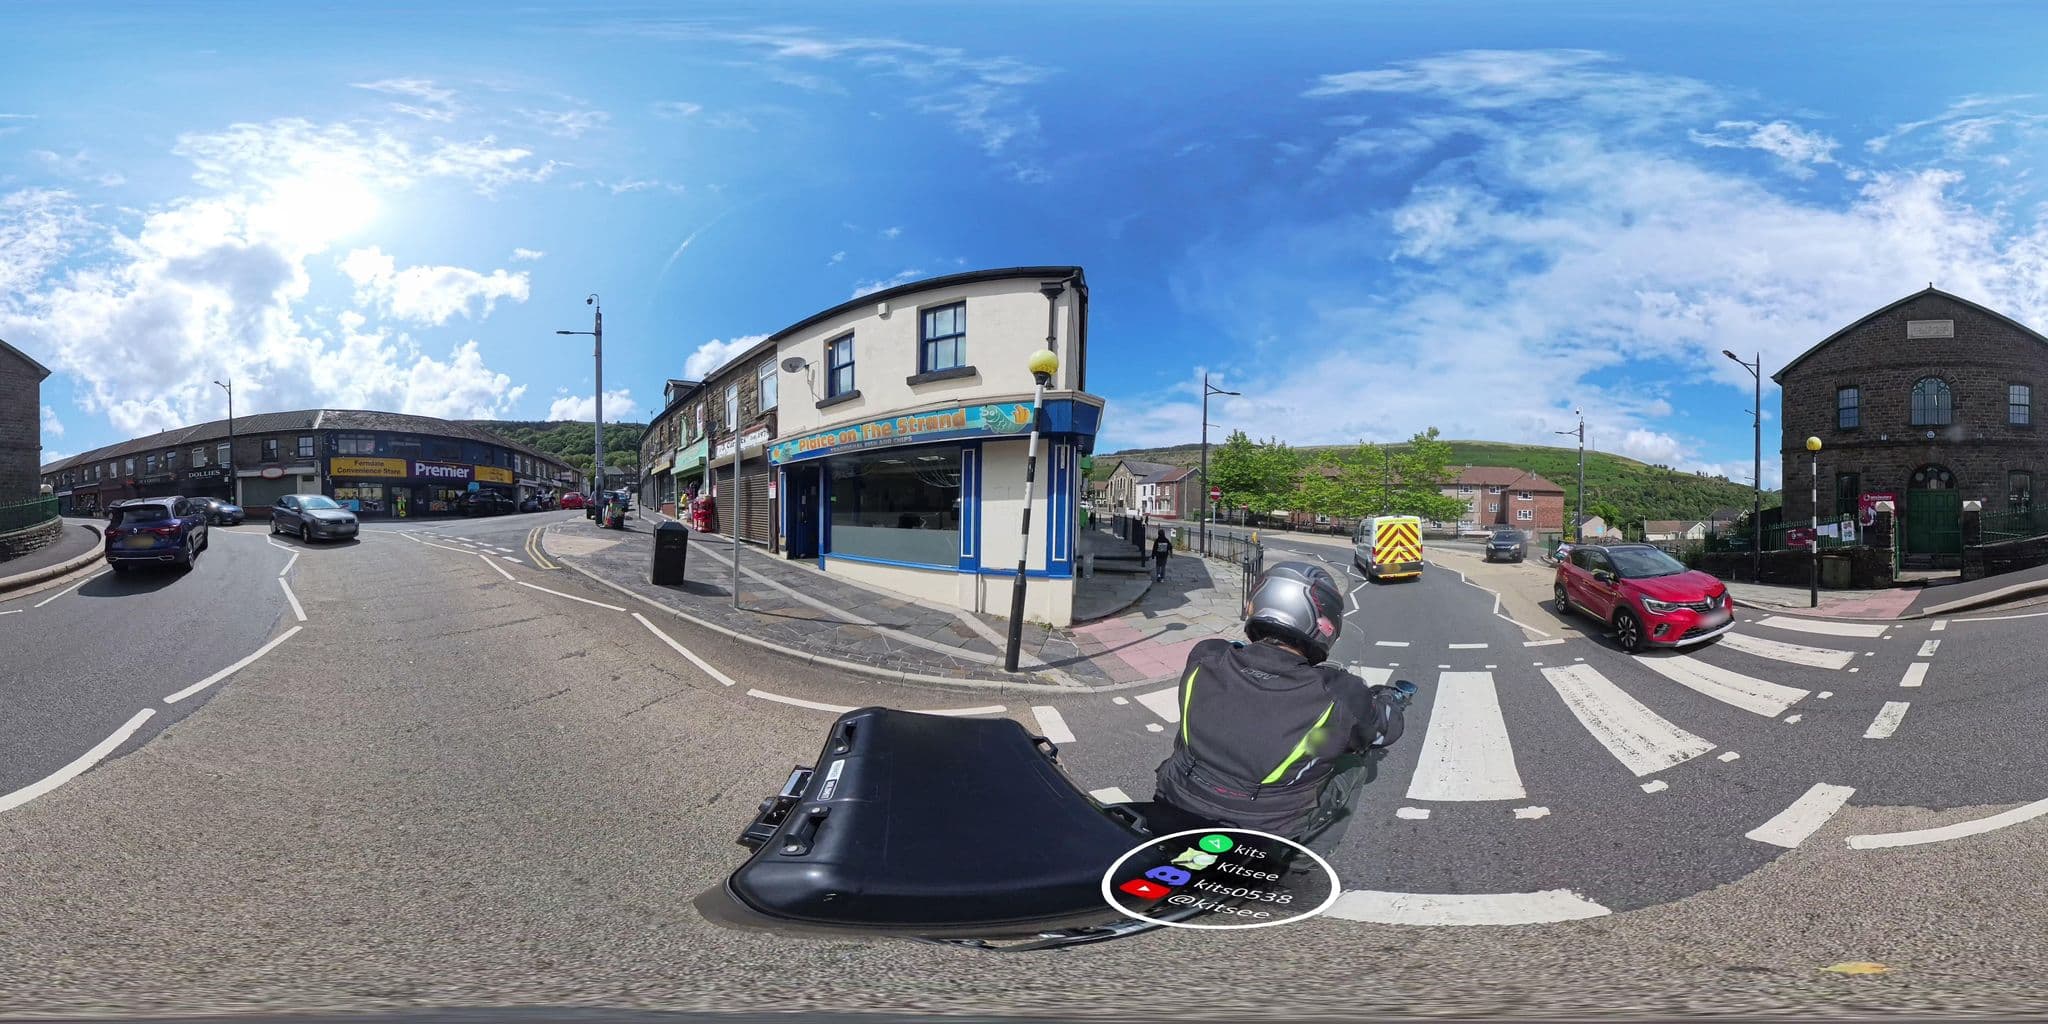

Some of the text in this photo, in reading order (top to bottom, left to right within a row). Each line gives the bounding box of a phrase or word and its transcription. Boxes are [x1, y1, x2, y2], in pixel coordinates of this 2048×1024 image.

[799, 408, 966, 452] Plaice on The Strand
[188, 469, 221, 478] DOLLIES
[415, 462, 470, 478] Premier
